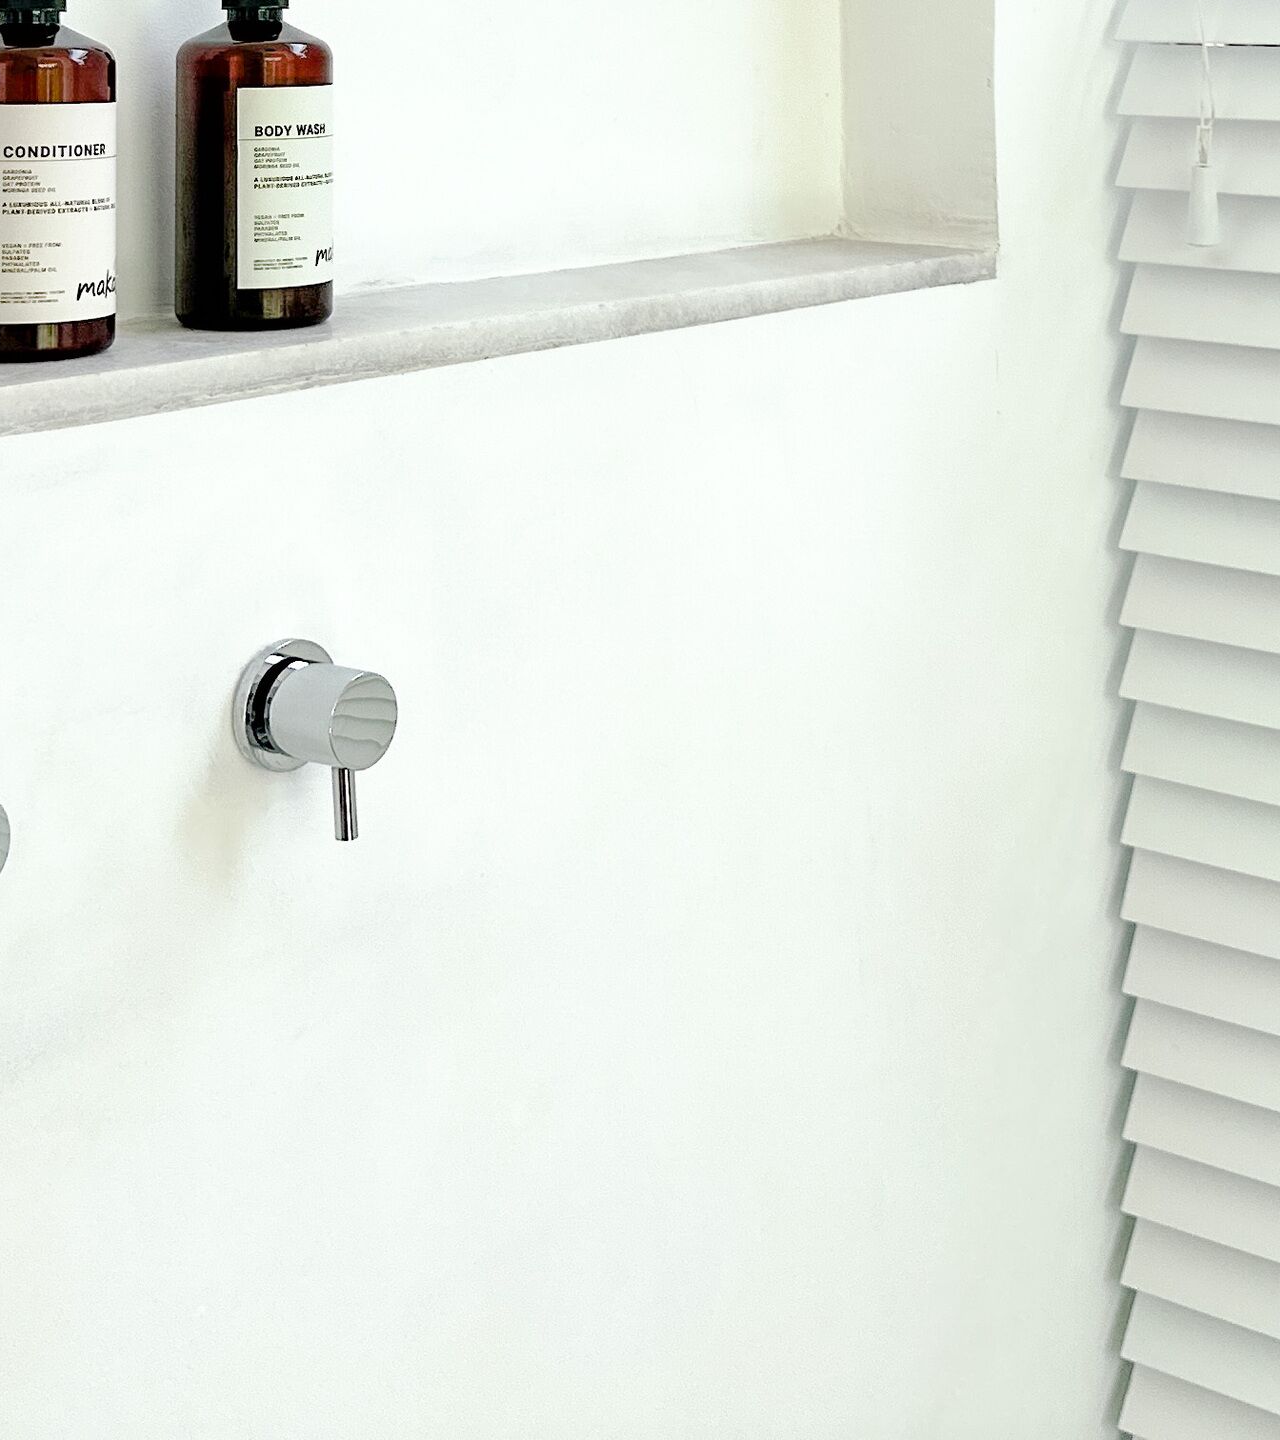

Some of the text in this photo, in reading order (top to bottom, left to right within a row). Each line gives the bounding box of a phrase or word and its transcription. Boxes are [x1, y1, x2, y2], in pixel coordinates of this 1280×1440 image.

[254, 123, 326, 137] BODY WASH
[3, 143, 106, 158] CONDITIONER
